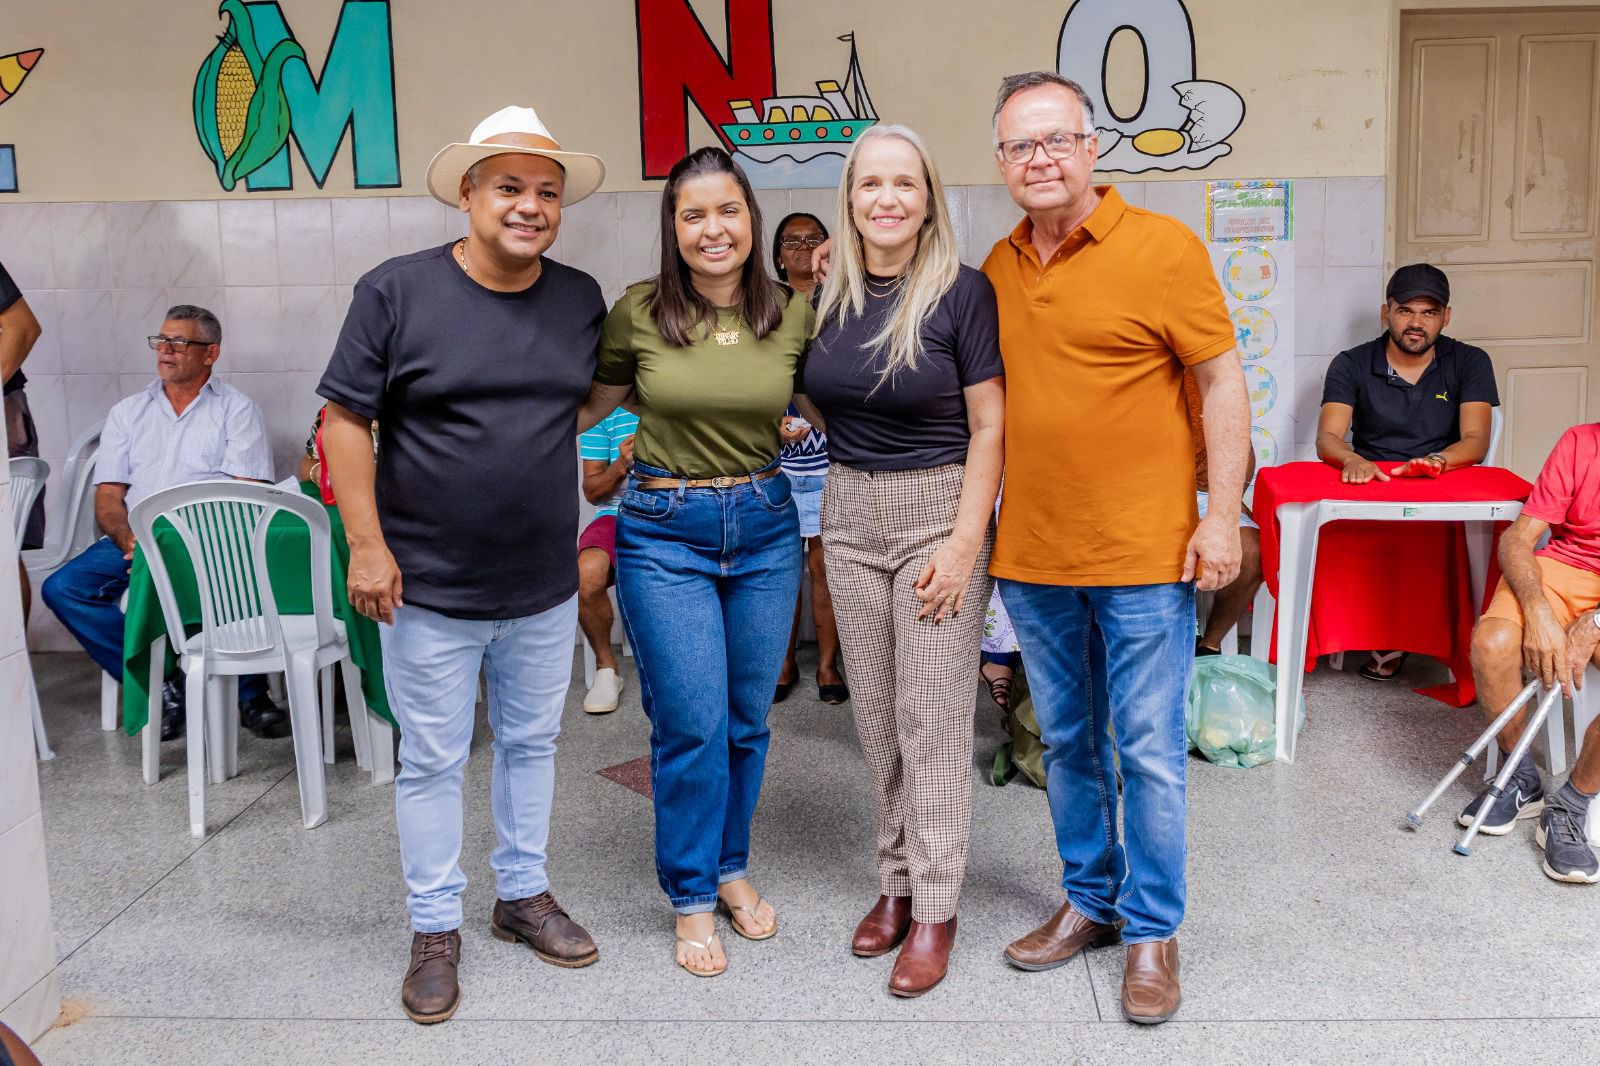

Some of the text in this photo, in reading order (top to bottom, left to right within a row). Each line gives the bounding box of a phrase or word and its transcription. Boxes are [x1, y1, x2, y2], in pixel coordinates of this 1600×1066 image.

[240, 0, 402, 192] M
[636, 0, 777, 181] N
[1057, 0, 1197, 140] O
